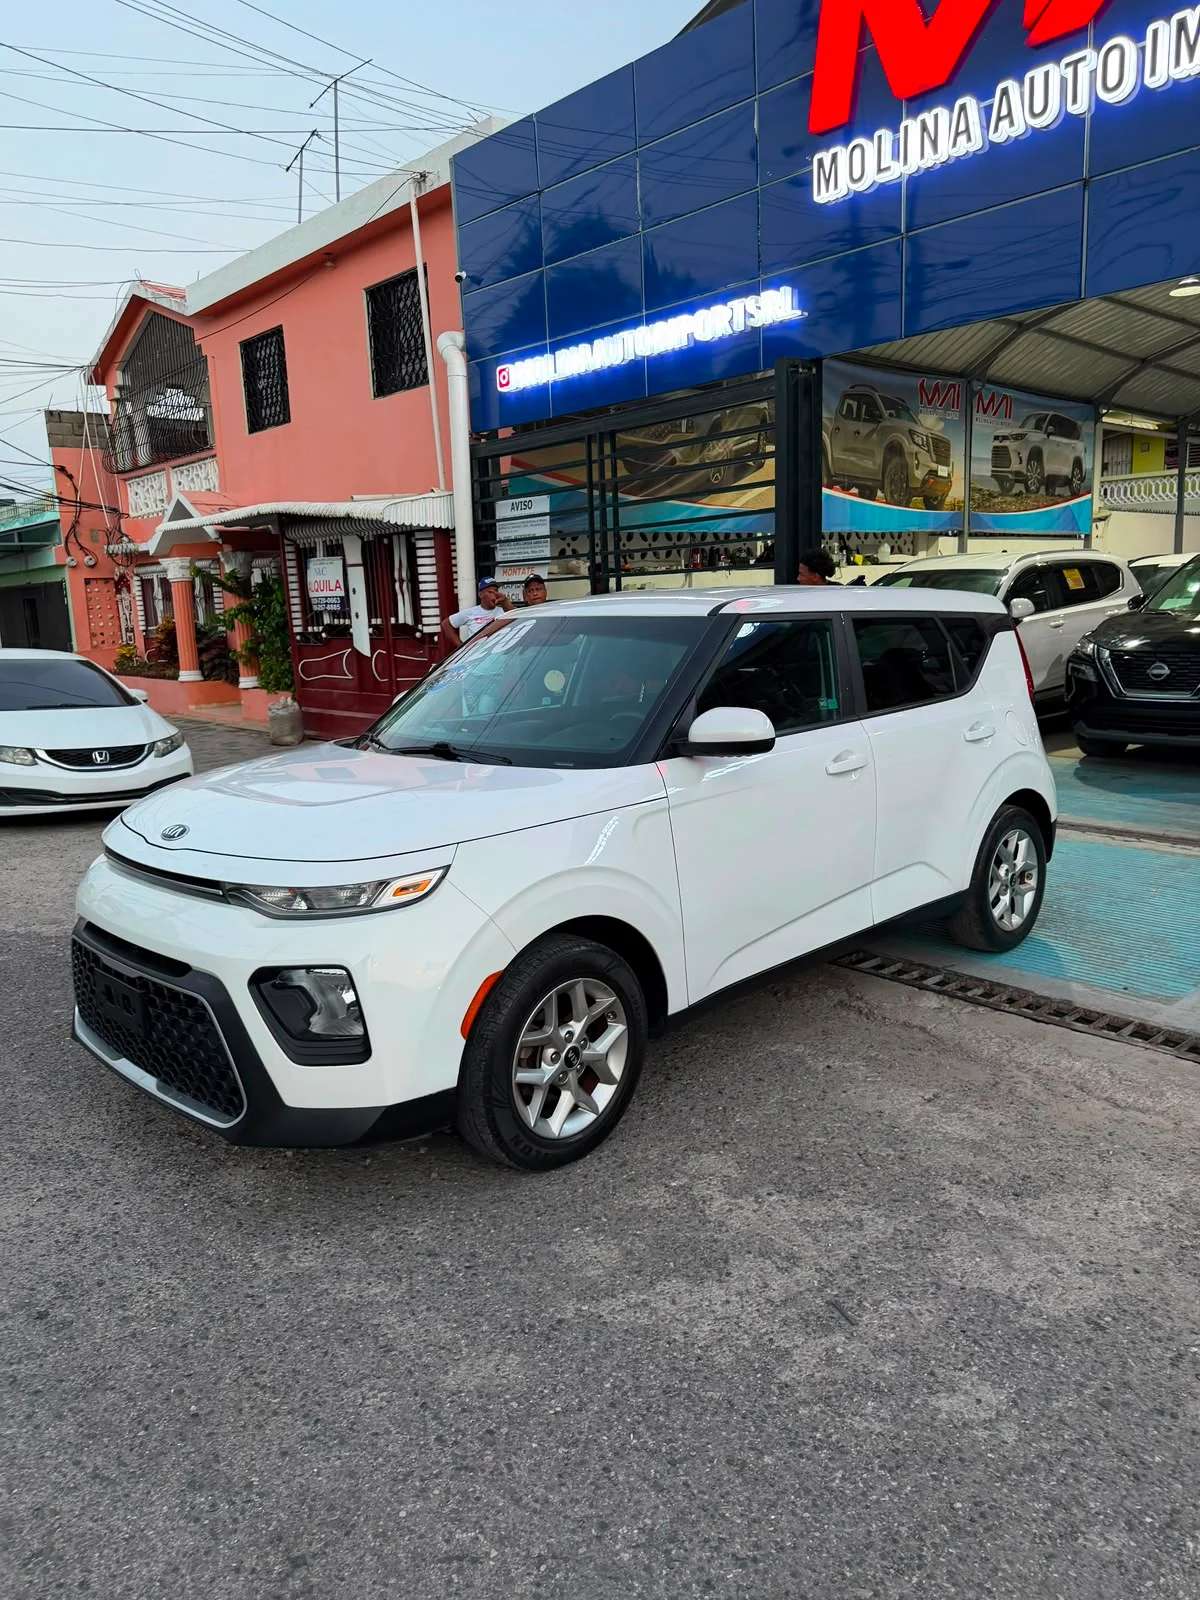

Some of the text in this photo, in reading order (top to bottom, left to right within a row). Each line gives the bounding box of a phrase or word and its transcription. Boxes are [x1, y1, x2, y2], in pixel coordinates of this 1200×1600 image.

[814, 98, 983, 203] MOLINA
[988, 37, 1138, 143] AUTO
[510, 499, 533, 512] AVISO
